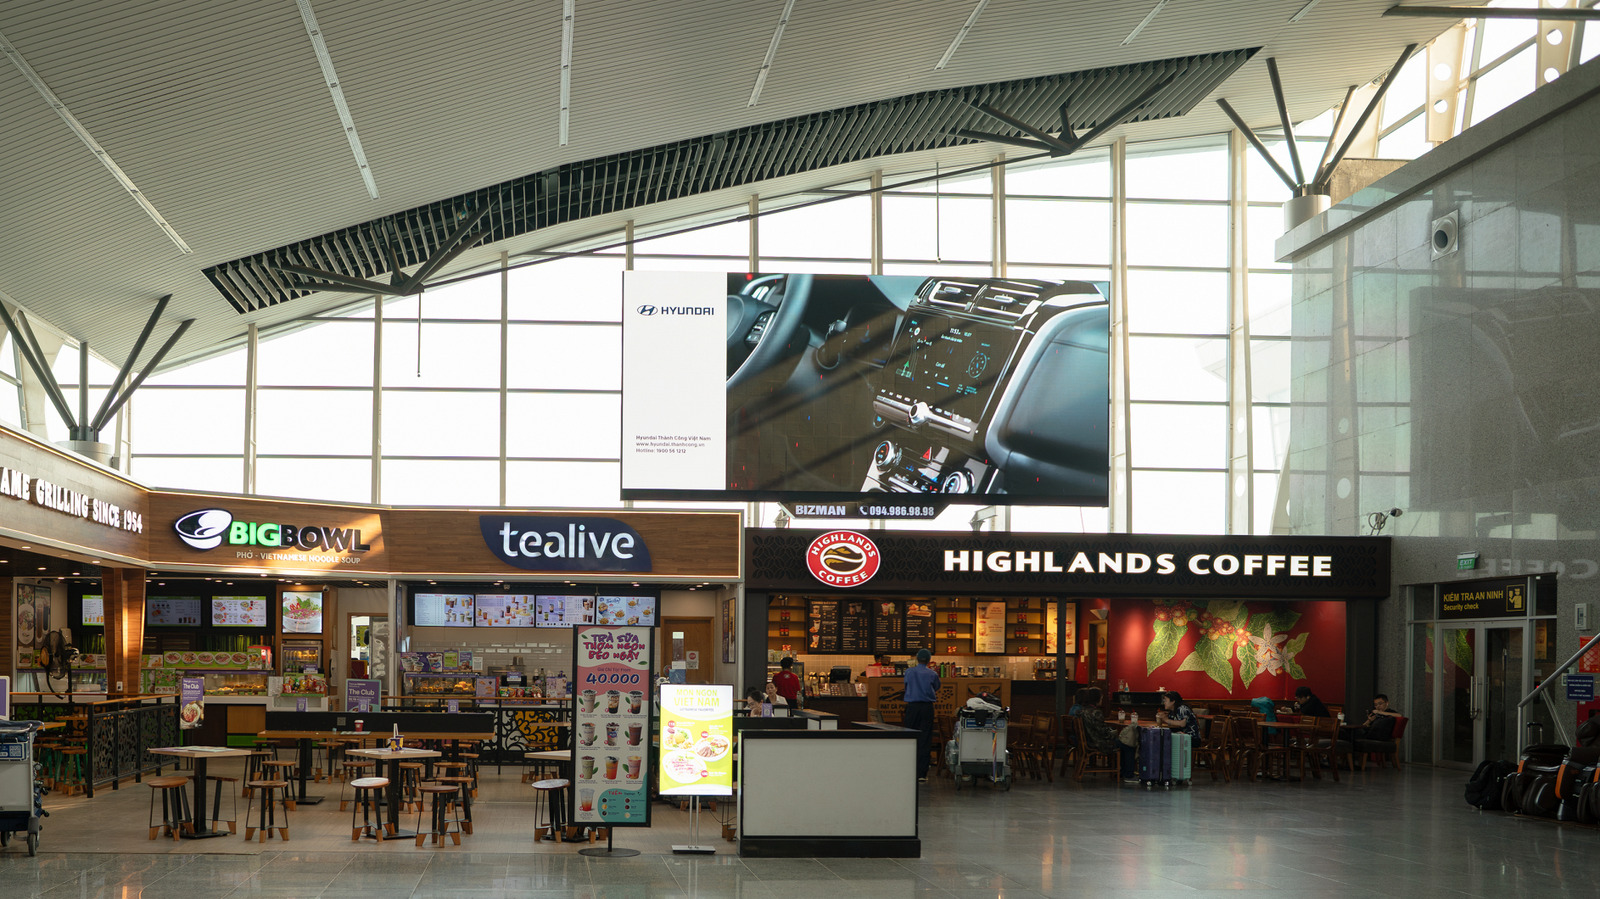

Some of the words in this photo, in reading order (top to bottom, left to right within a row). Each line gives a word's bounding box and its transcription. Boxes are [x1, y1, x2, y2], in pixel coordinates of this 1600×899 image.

[661, 306, 714, 315] HYUNDAI
[36, 478, 88, 518] GRILLING
[92, 498, 120, 528] SINCE
[124, 509, 142, 534] 1954
[795, 505, 846, 516] BIZMAN
[869, 506, 934, 516] 094.986.98.98
[499, 522, 634, 559] tealive
[811, 534, 876, 558] HIGHLANDS
[261, 553, 307, 562] VIETNAMESE
[309, 554, 339, 563] NOODLE
[944, 550, 1176, 575] HIGHLANDS
[1188, 554, 1332, 576] COFFEE
[818, 570, 868, 584] COFFEE
[1486, 591, 1504, 599] NINH
[591, 632, 613, 642] TRÀ
[617, 632, 639, 643] SỮA
[586, 673, 639, 684] 40.000
[698, 698, 720, 707] NAM
